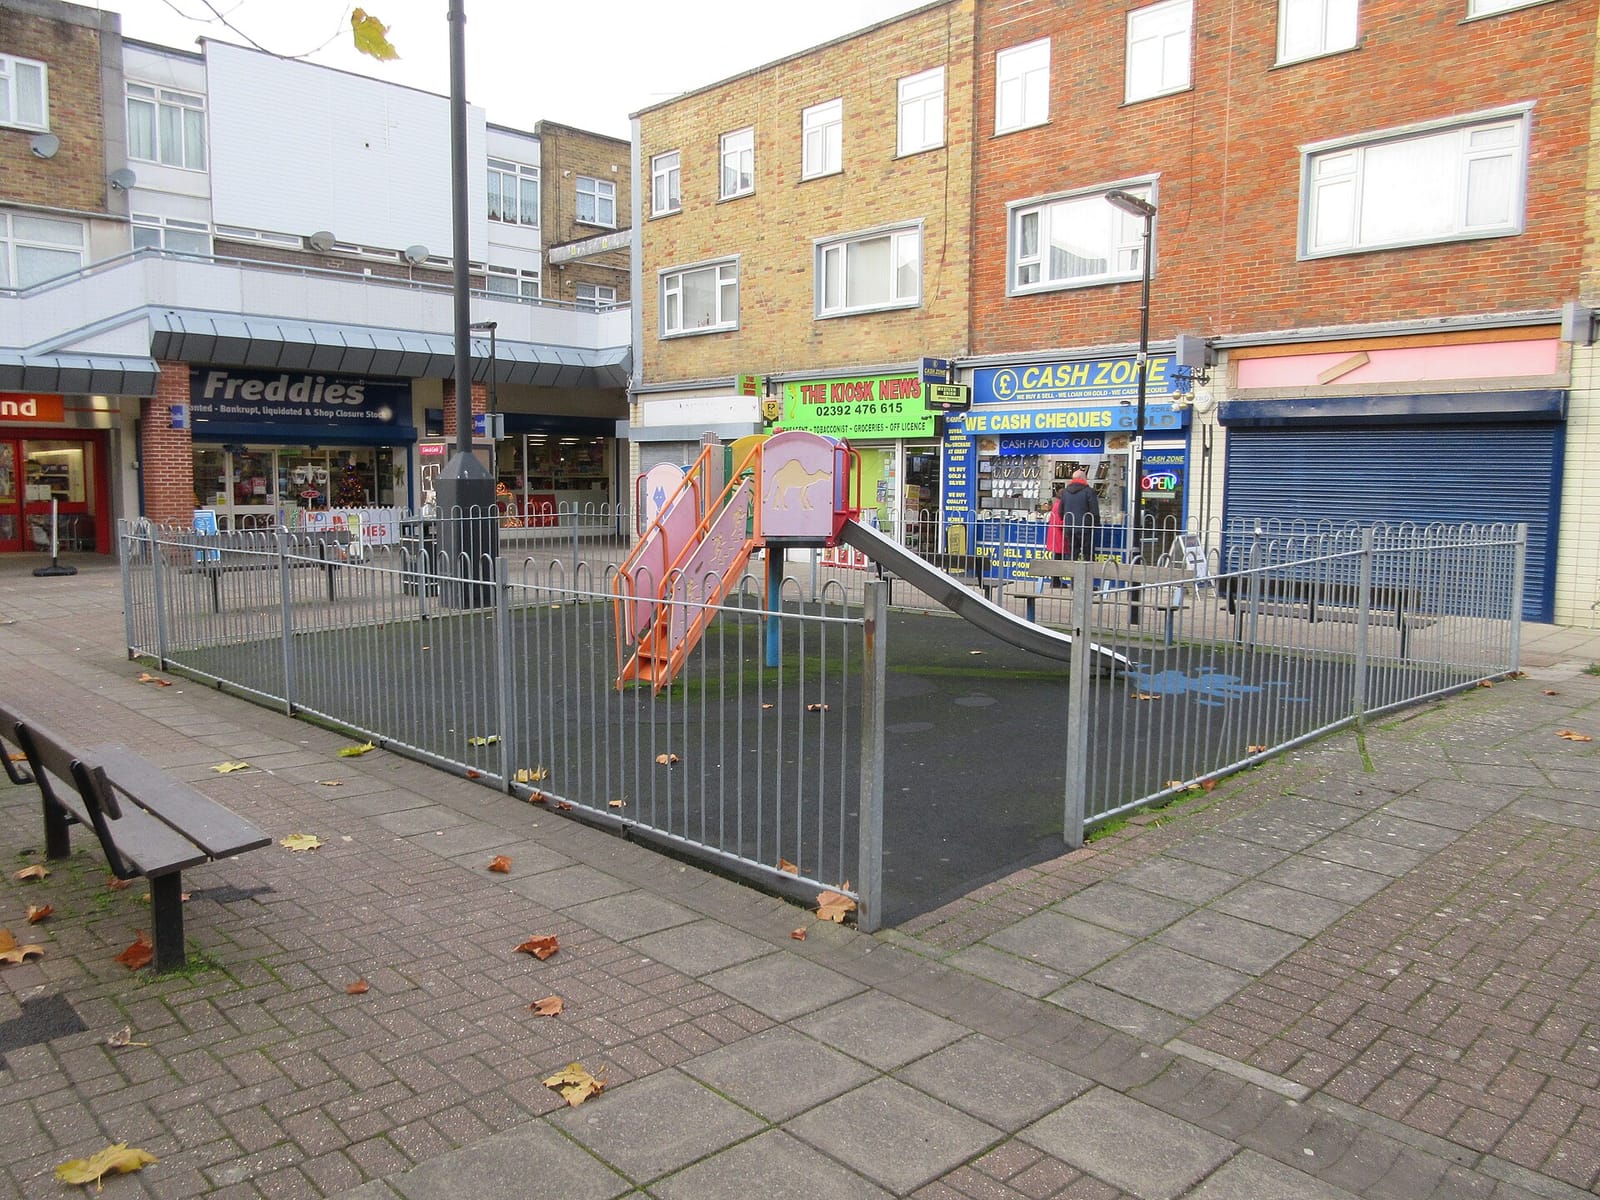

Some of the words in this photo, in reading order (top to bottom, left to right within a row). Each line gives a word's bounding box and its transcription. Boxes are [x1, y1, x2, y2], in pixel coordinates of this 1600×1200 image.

[1022, 364, 1090, 389] CASH
[1093, 358, 1169, 385] ZONE
[204, 371, 366, 405] Freddies
[800, 384, 826, 404] THE
[830, 381, 874, 403] KIOSK
[878, 378, 922, 400] NEWS
[220, 405, 261, 415] Bankrupt,
[262, 406, 302, 416] liquidated
[314, 409, 334, 419] Shop
[816, 406, 851, 416] 02392
[855, 404, 876, 414] 476
[880, 403, 902, 413] 615
[813, 425, 848, 433] TOBACCONIST
[854, 423, 884, 432] GROCERIES
[890, 423, 900, 431] OFF
[902, 422, 926, 431] LICENCE
[965, 416, 986, 431] WE
[990, 414, 1030, 430] CASH
[1035, 410, 1112, 428] CHEQUES
[1001, 440, 1025, 449] CASH
[1028, 440, 1049, 448] PAID
[1052, 439, 1070, 448] FOR
[1072, 438, 1101, 448] GOLD
[1142, 476, 1174, 490] OPEN
[976, 547, 997, 558] BUY,
[1026, 550, 1032, 559] &
